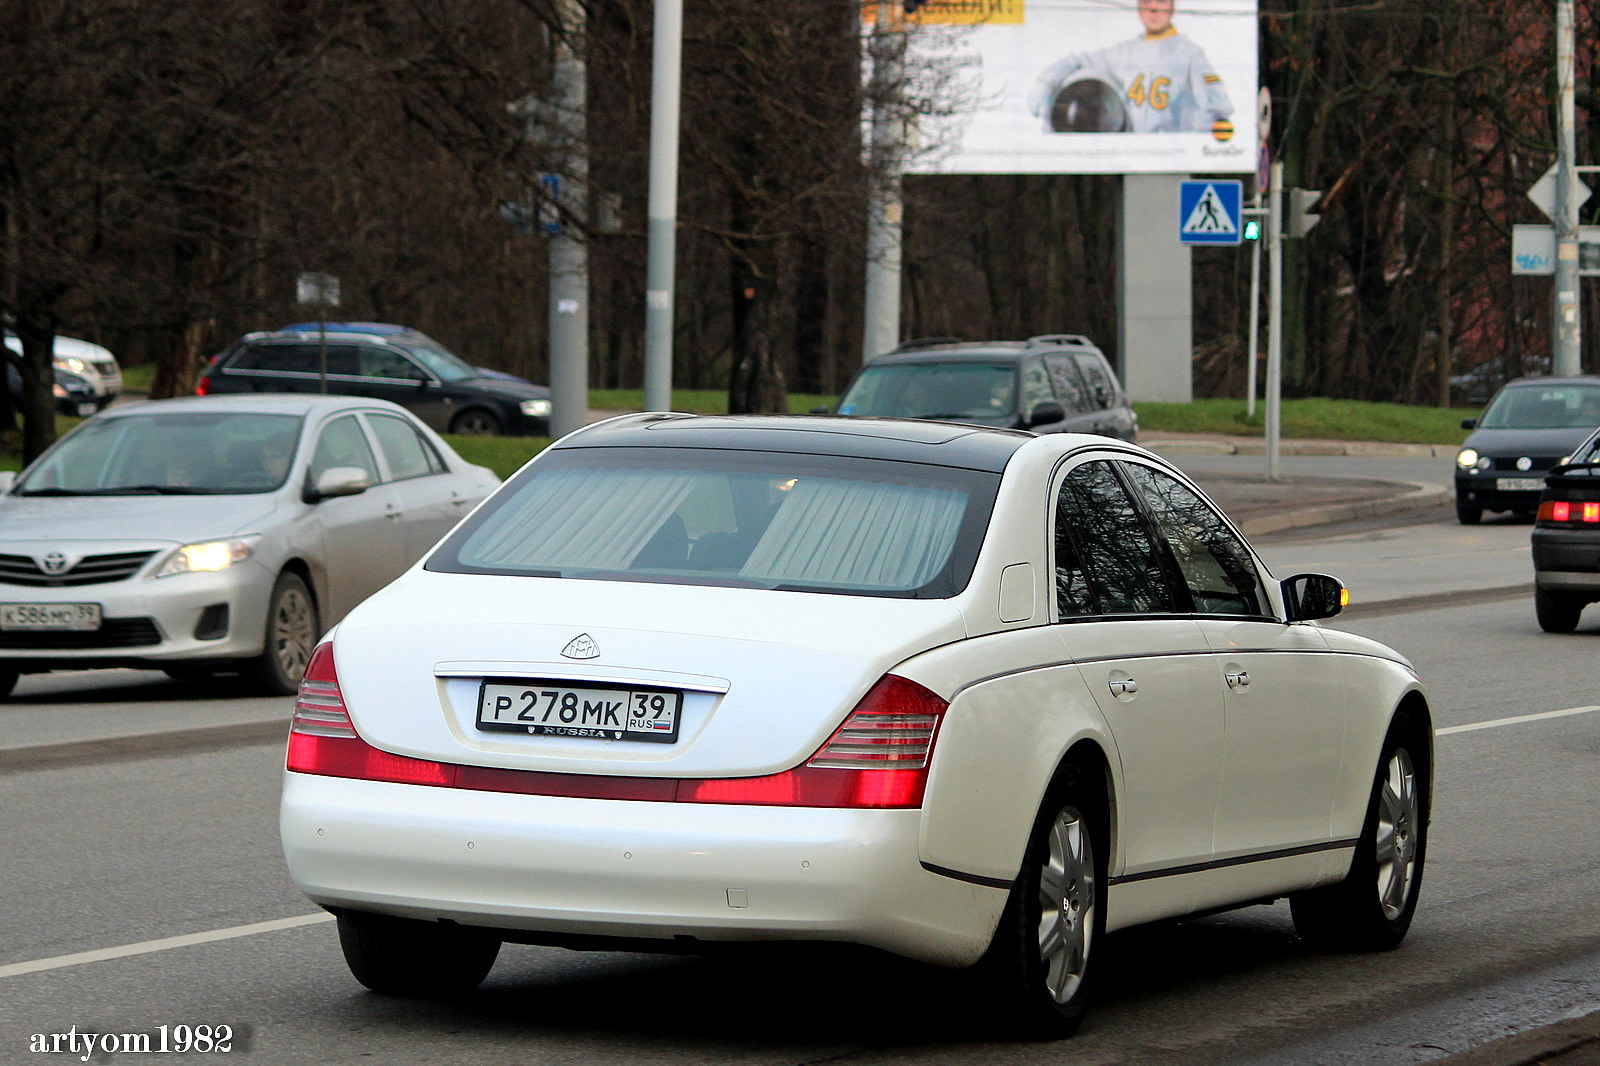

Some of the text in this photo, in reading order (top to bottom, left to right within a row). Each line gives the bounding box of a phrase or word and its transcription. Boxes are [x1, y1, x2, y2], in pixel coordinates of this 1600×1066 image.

[1126, 74, 1170, 110] 4G
[632, 694, 666, 720] 39
[543, 726, 606, 738] RUSSIA
[629, 718, 653, 729] RUS
